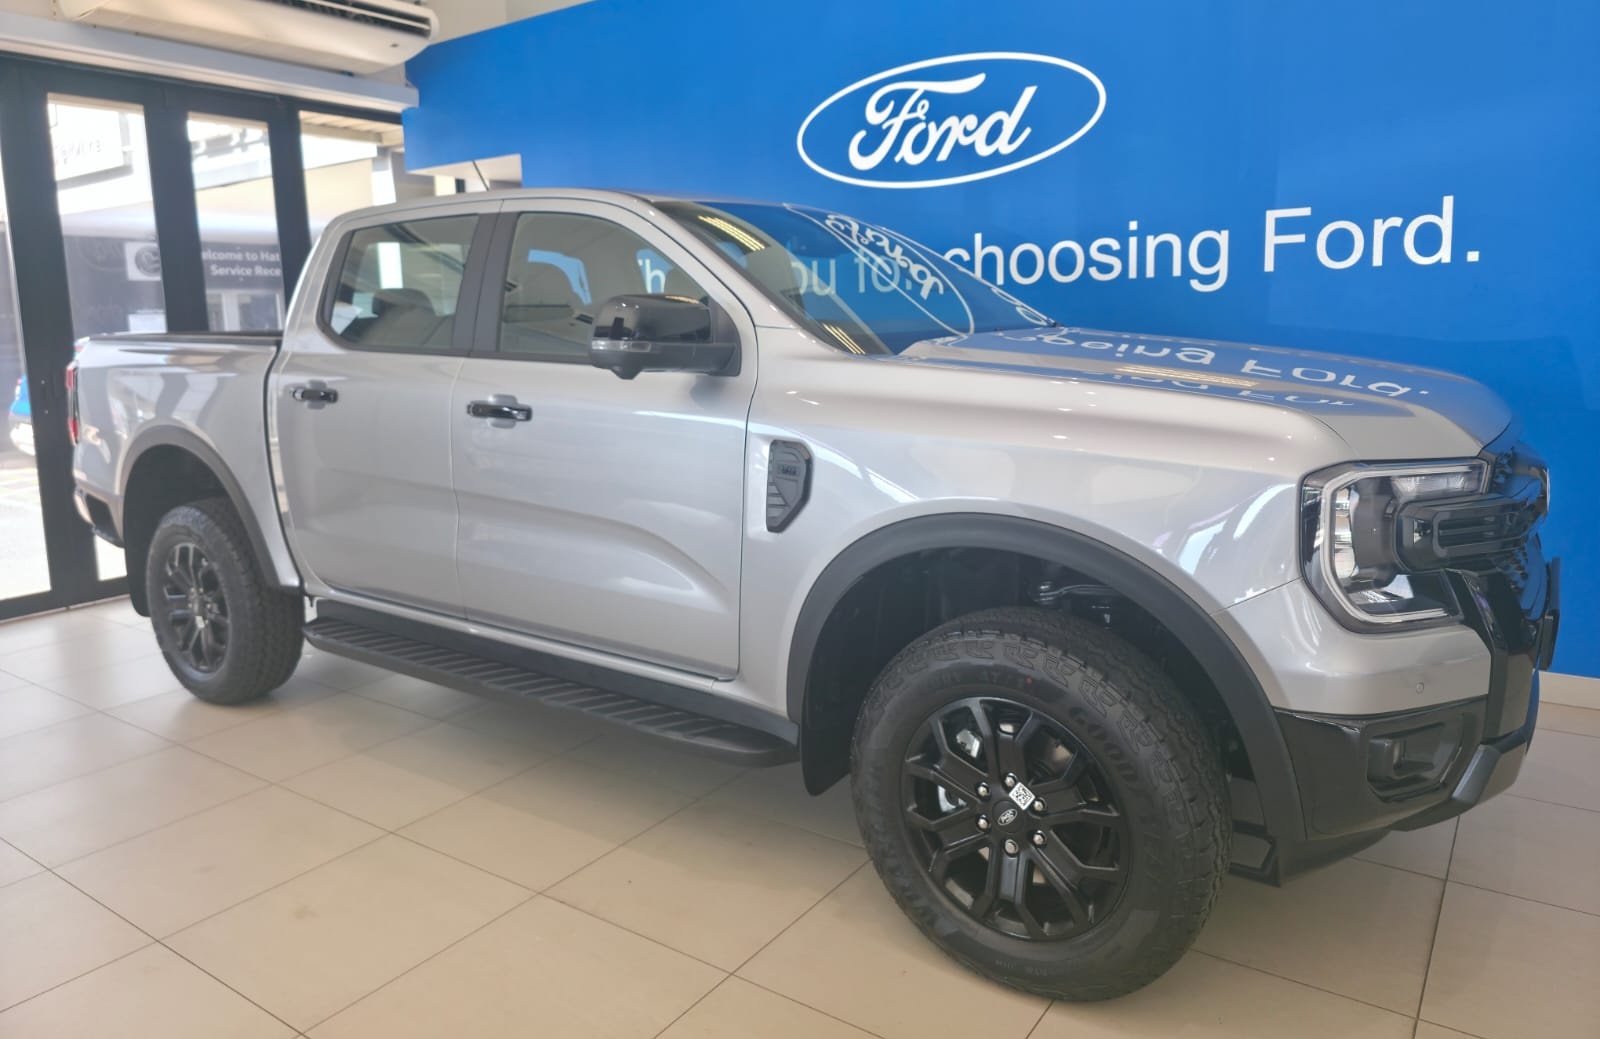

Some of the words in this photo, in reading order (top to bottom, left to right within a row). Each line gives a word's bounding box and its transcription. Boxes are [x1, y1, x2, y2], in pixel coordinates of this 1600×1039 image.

[848, 72, 1038, 170] Ford
[201, 248, 242, 261] elcome
[245, 251, 259, 261] to
[260, 250, 280, 262] Hat
[1263, 195, 1480, 273] Ford.
[210, 264, 253, 277] Service
[254, 265, 281, 277] Rece
